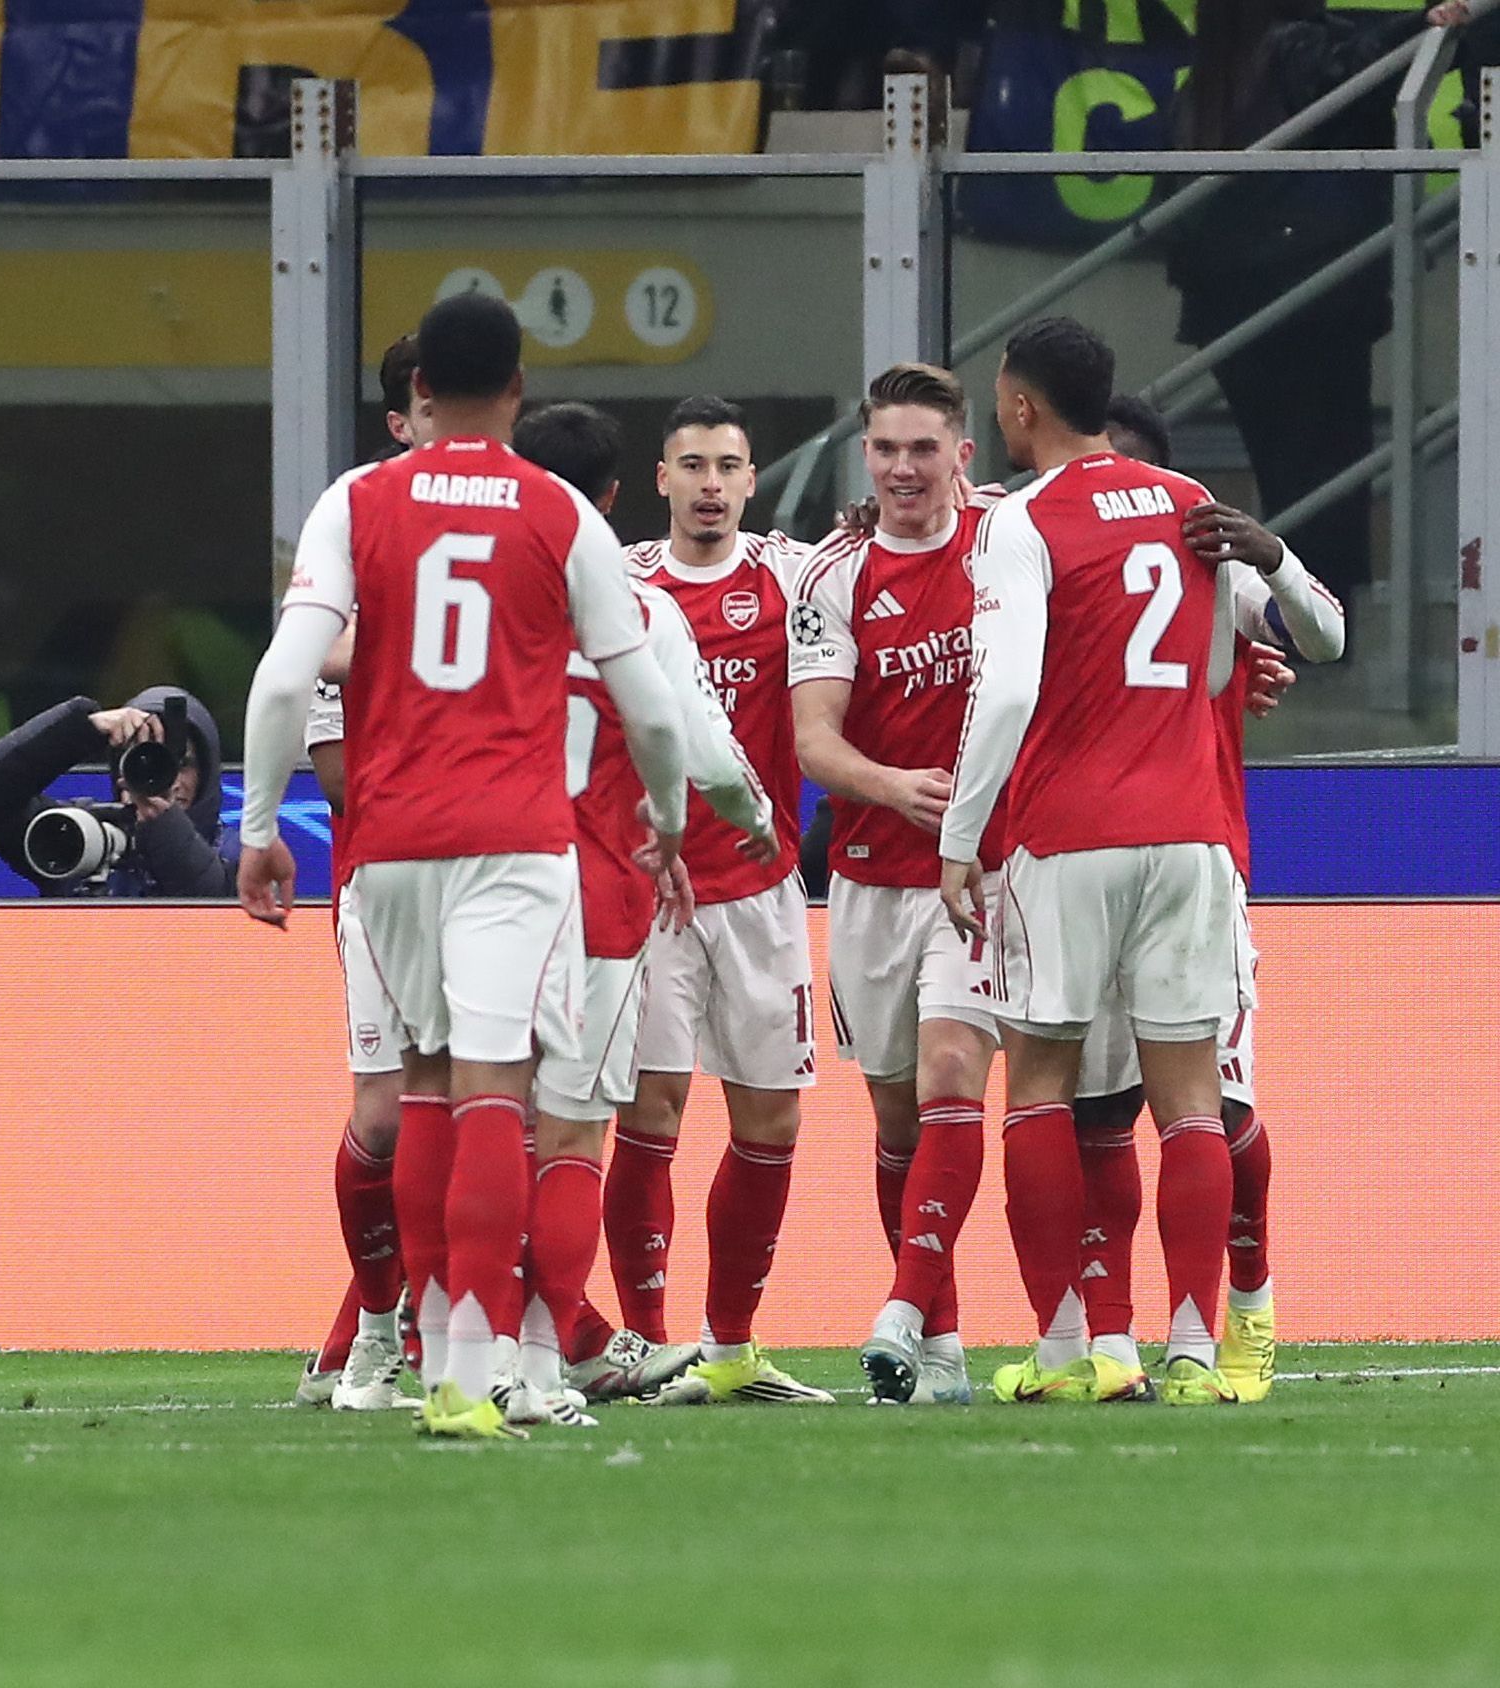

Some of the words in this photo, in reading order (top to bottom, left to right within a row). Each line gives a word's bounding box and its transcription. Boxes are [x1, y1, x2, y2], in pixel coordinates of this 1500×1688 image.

[645, 284, 680, 328] 12
[410, 472, 521, 510] GABRIEL
[1092, 484, 1176, 521] SALIBA
[410, 532, 497, 691] 6
[1123, 541, 1189, 688] 2
[875, 624, 974, 678] Emira
